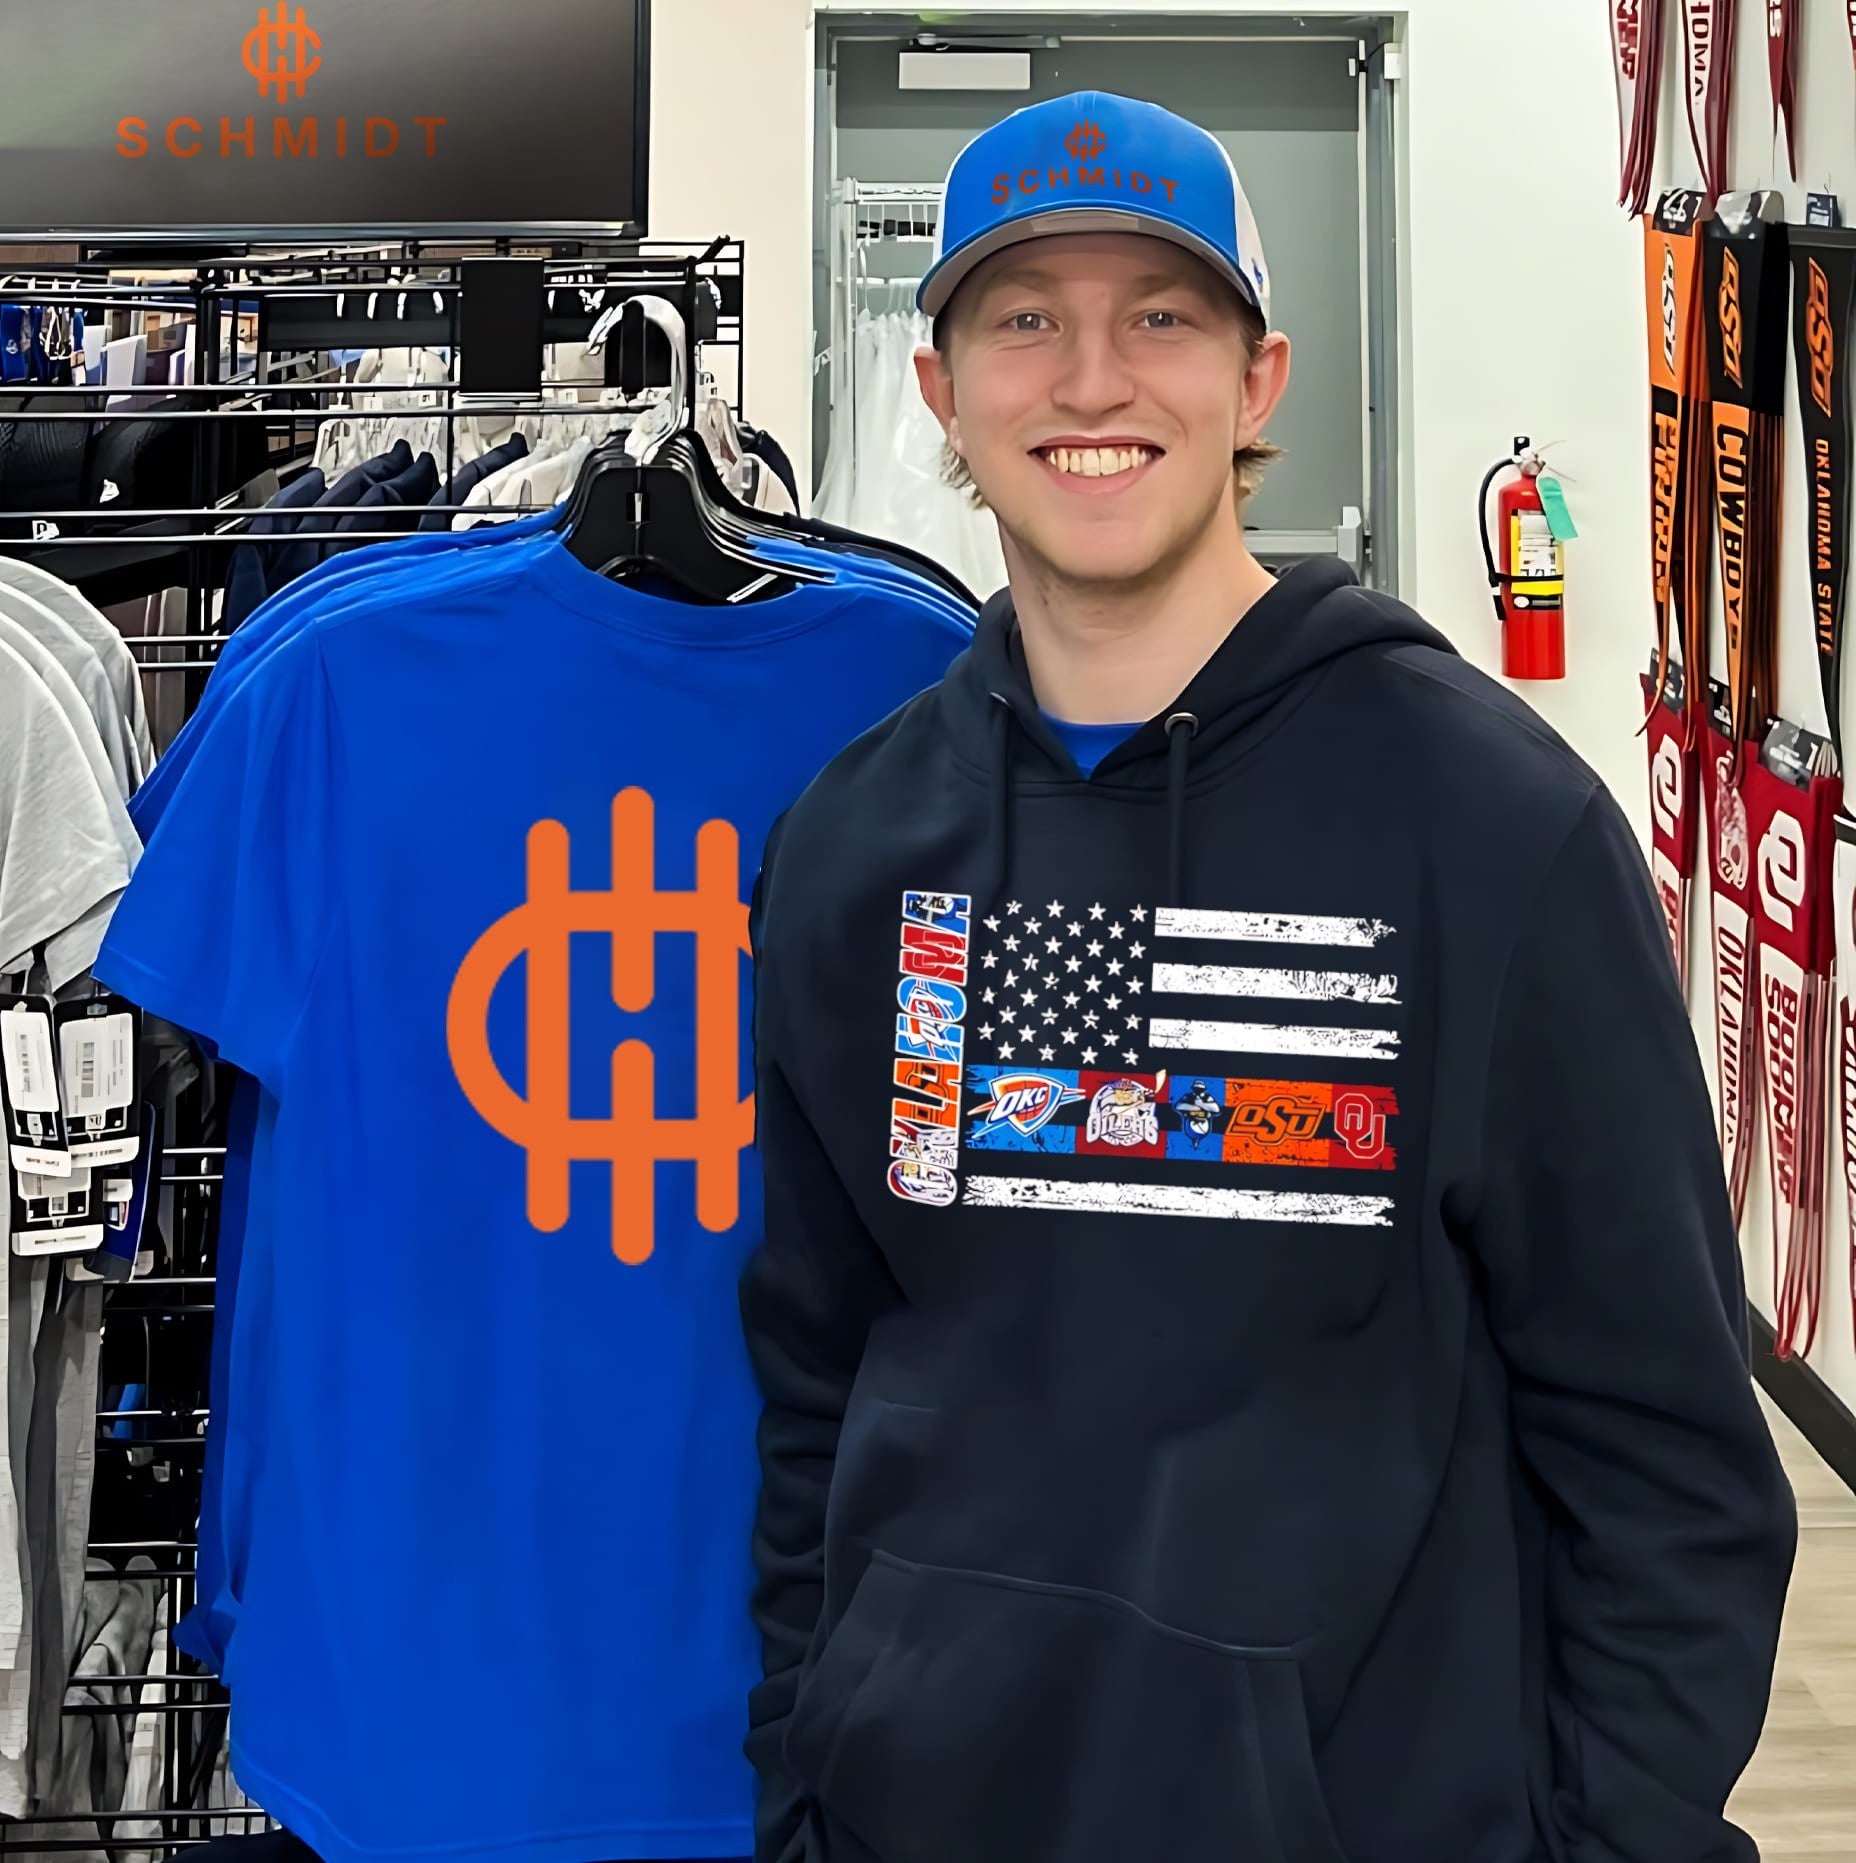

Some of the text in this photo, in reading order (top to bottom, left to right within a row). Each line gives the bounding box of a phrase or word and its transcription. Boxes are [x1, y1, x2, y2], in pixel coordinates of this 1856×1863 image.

[115, 117, 447, 158] SCHMIDT
[991, 167, 1179, 204] SCHMIDT
[1816, 438, 1832, 570] OKLAHOMA
[1757, 810, 1805, 932] OU
[887, 890, 971, 1207] OKLAHOMA
[1718, 926, 1745, 1144] OKLAHOMA
[990, 1086, 1049, 1122] OKC
[1226, 1095, 1327, 1146] OSU
[1334, 1093, 1386, 1159] OU
